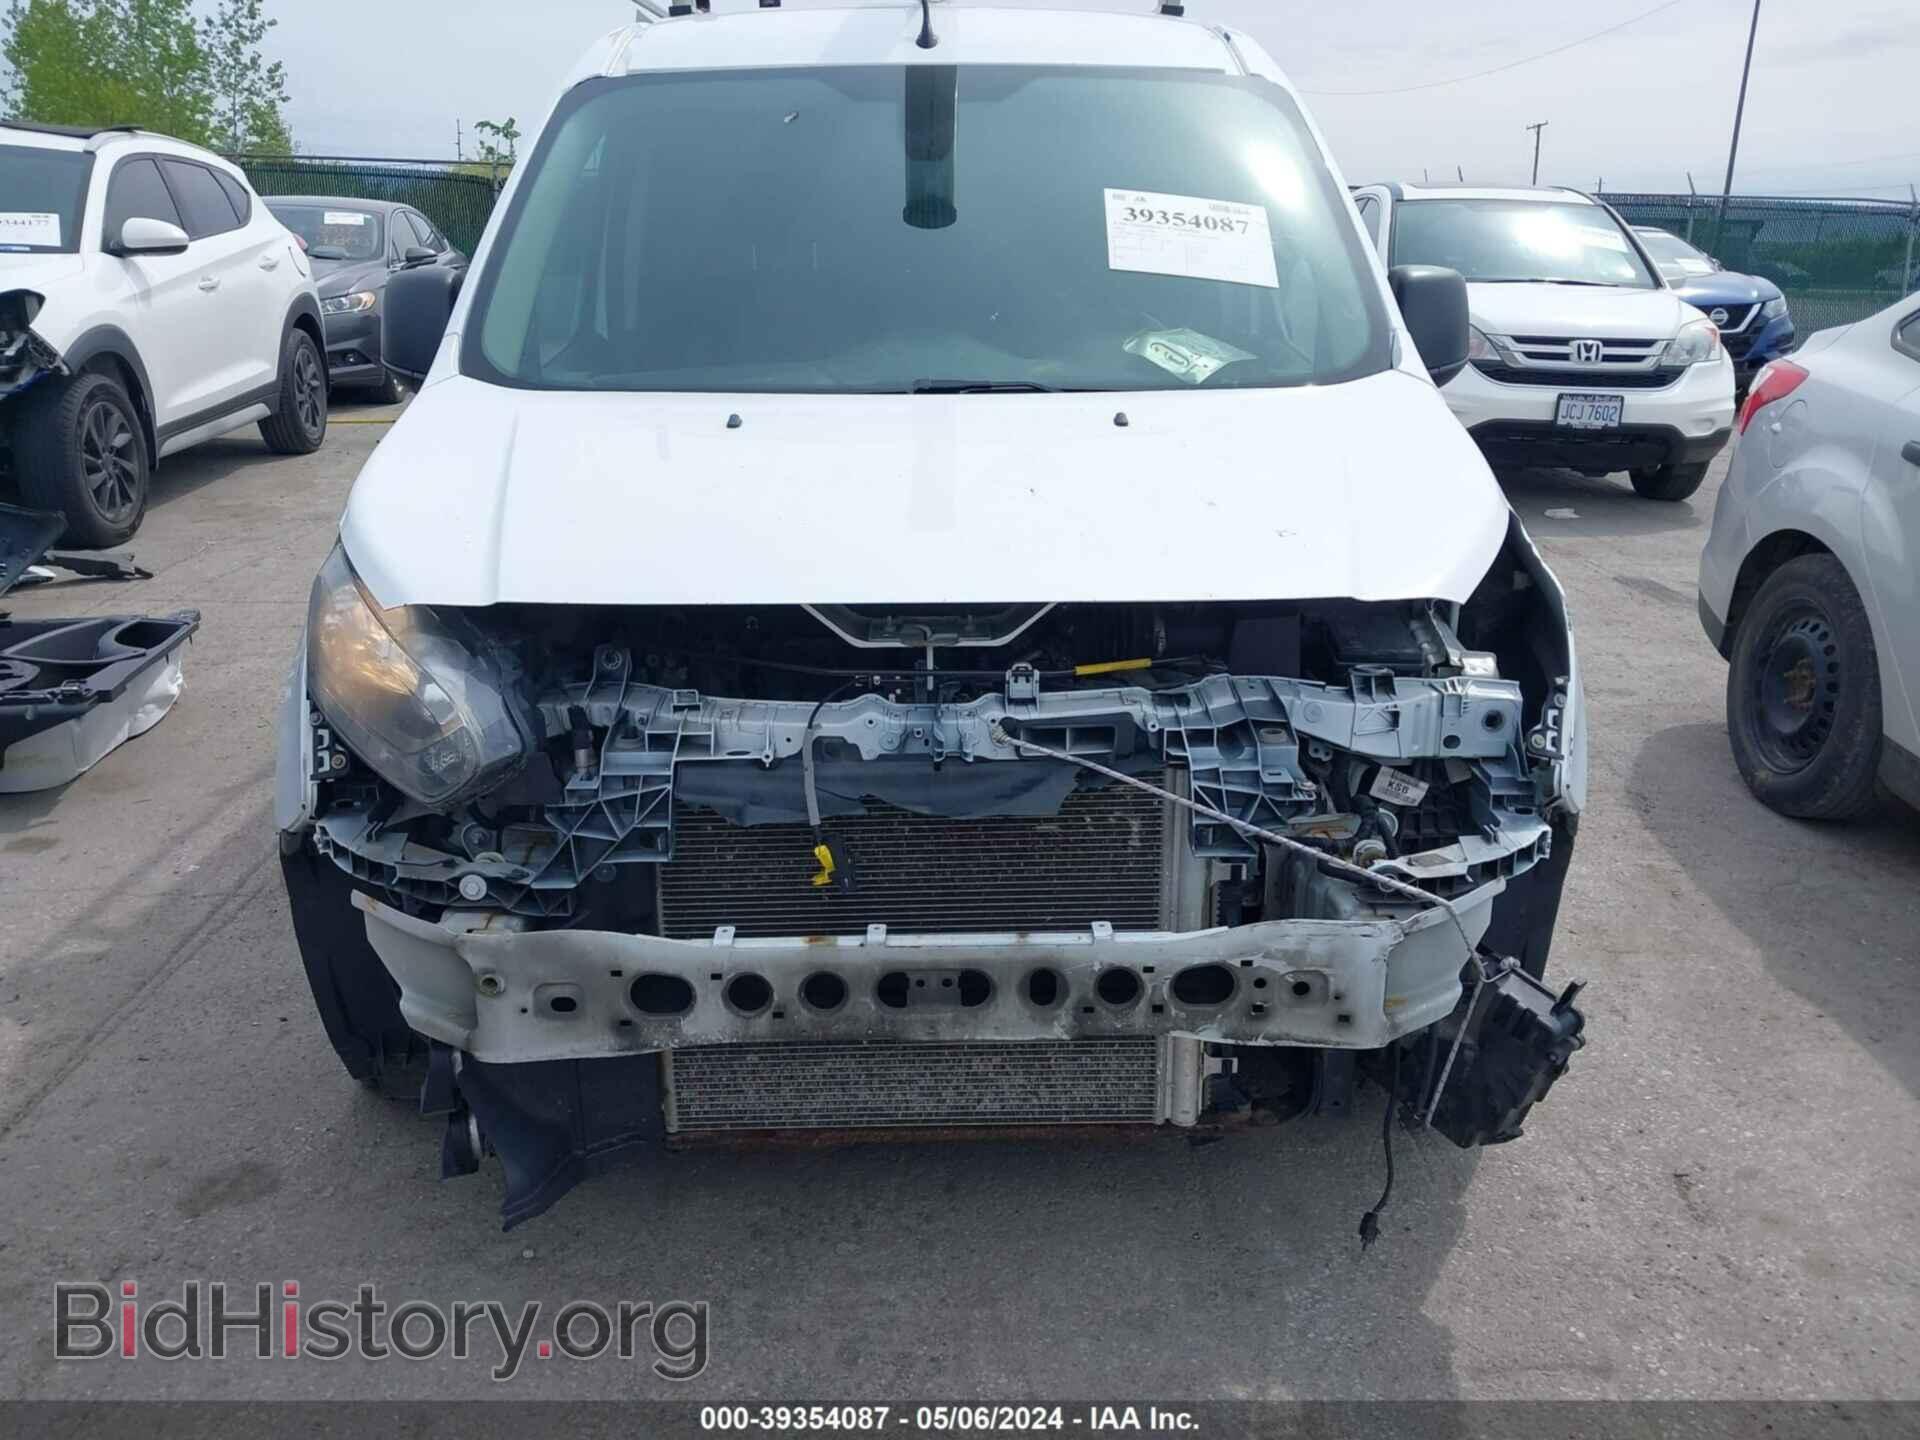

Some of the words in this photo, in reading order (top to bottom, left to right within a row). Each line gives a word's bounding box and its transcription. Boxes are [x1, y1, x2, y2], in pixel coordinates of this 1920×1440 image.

[1123, 206, 1249, 235] 39354087
[1560, 403, 1585, 420] JCJ
[1587, 405, 1618, 422] 7602
